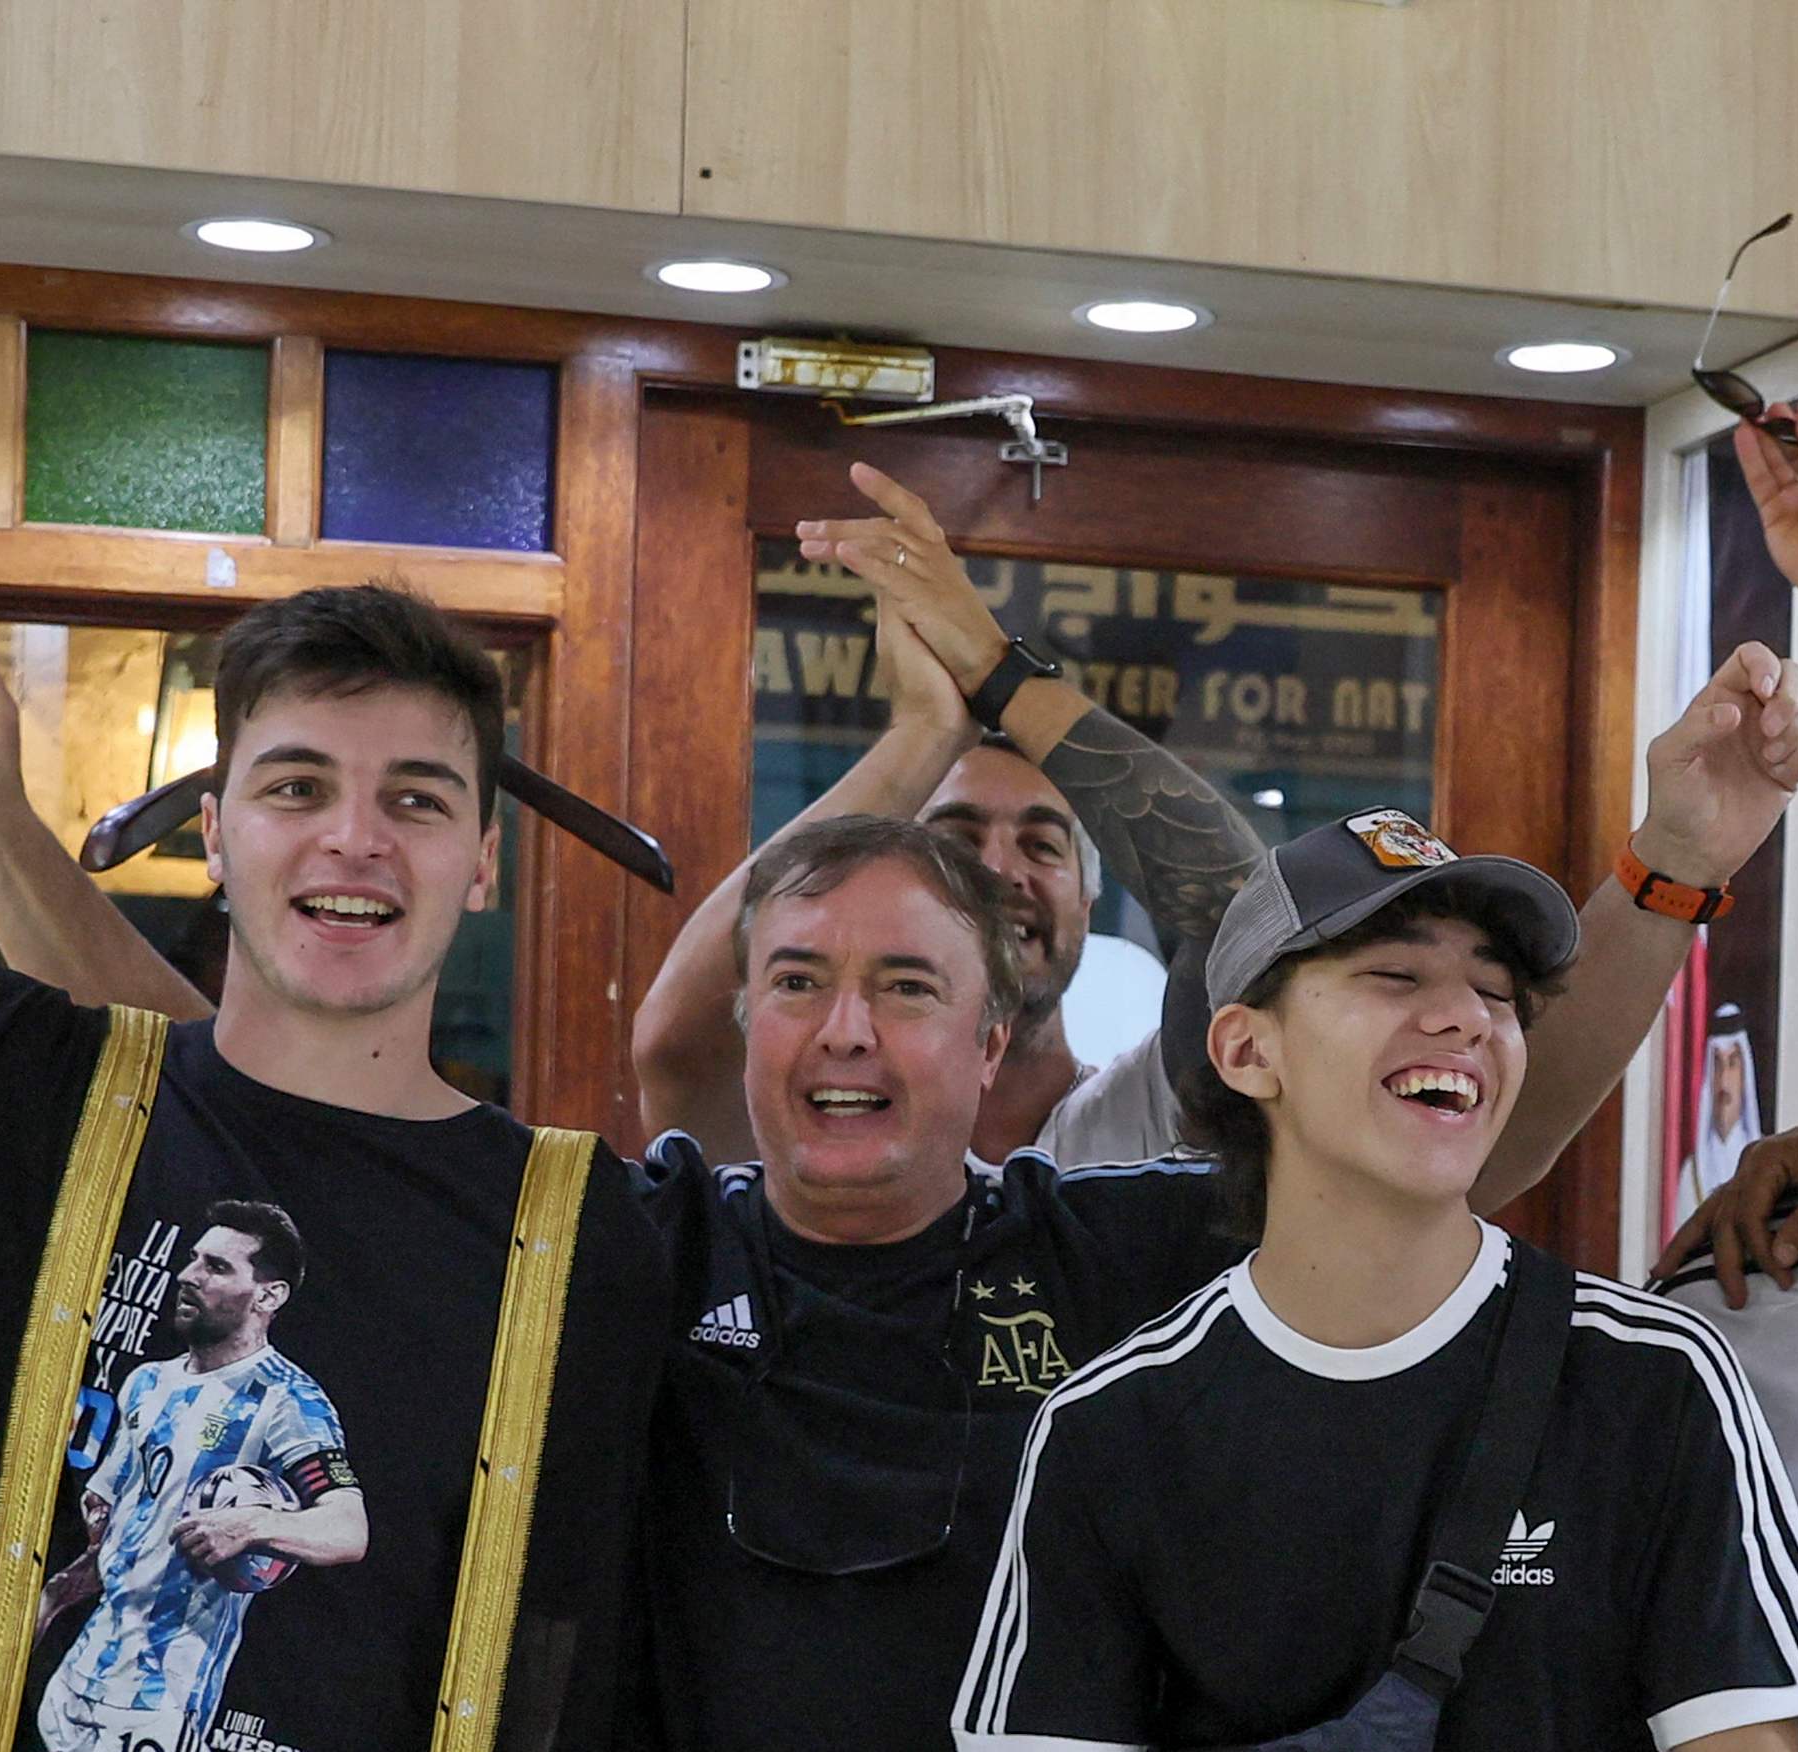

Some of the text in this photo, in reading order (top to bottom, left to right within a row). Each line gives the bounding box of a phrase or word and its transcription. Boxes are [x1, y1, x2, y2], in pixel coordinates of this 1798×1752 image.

[1203, 668, 1308, 726] FOR
[139, 1220, 181, 1268] LA
[689, 1324, 762, 1350] adidas
[1490, 1563, 1556, 1585] didas
[223, 1708, 266, 1739] LIONEL
